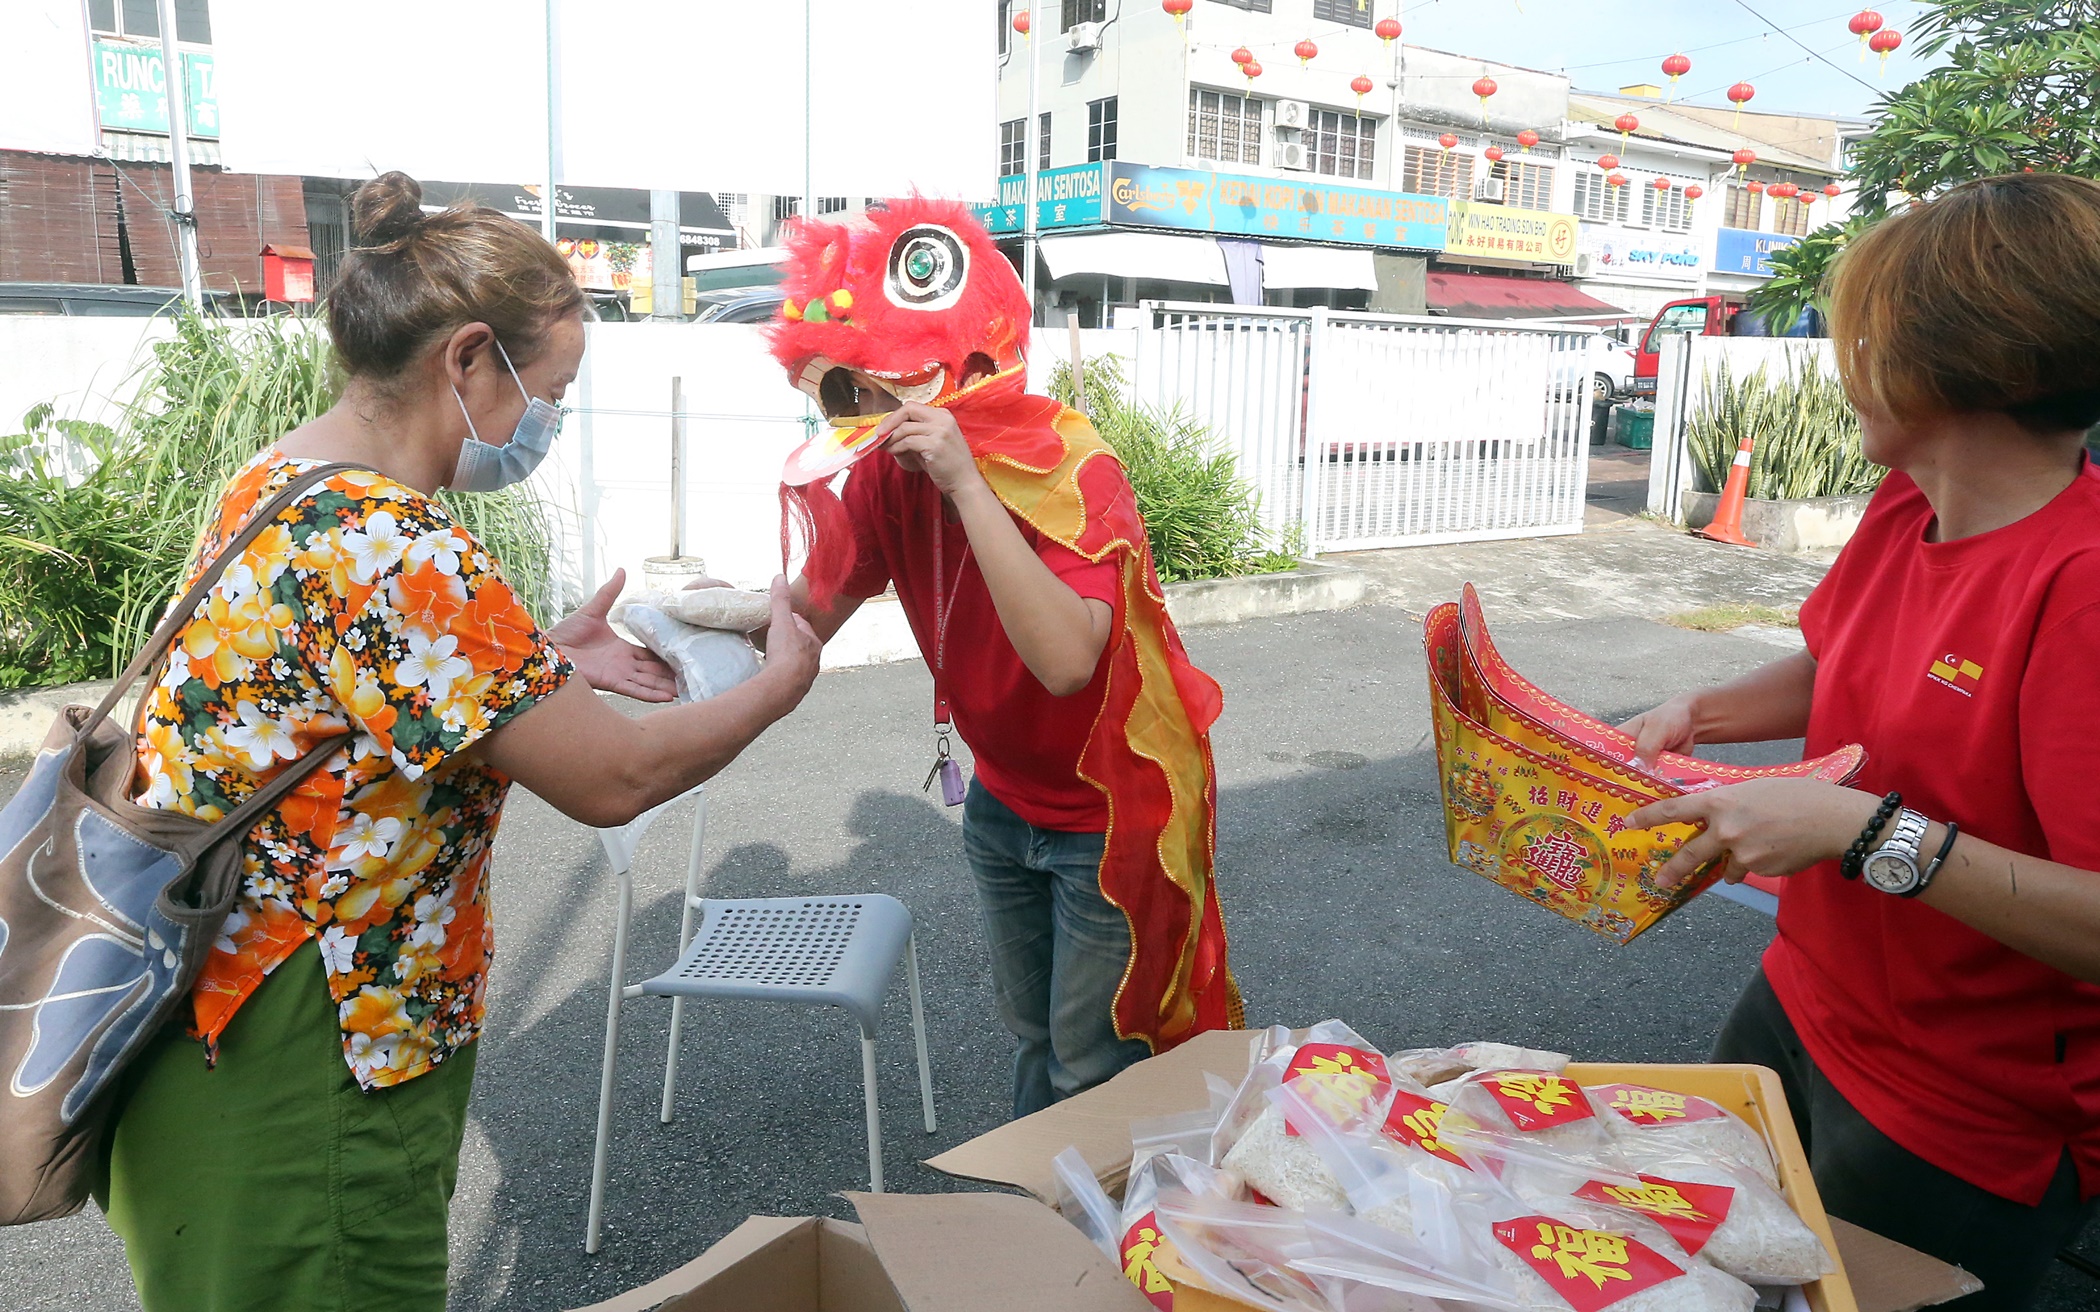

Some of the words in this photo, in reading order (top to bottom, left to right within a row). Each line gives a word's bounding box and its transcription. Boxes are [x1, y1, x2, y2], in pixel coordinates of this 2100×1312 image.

[102, 50, 183, 94] RUNC
[1002, 176, 1052, 206] MAKAN
[1054, 169, 1100, 200] SENTOSA
[1112, 177, 1176, 209] Carlsberg
[1220, 180, 1262, 207] KEDAI
[1263, 184, 1294, 213] KOPI
[1297, 188, 1325, 214] DAN
[1327, 191, 1392, 221] MAKANAN
[1394, 197, 1446, 225] SENTOSA
[680, 234, 720, 247] 6848308
[1446, 210, 1465, 246] RONG
[1468, 212, 1480, 229] WIN
[1481, 214, 1495, 232] HAO
[1495, 216, 1521, 234] TRADING
[1521, 219, 1534, 236] SDN
[1534, 221, 1547, 237] BHD
[1466, 234, 1544, 254] 永好貿易有限公司
[1628, 249, 1660, 264] SKY
[1660, 251, 1700, 267] POND
[1755, 238, 1790, 254] KLINIK
[1528, 785, 1628, 839] 招財進寶
[1610, 1089, 1687, 1122] 福
[1531, 1222, 1633, 1291] 福
